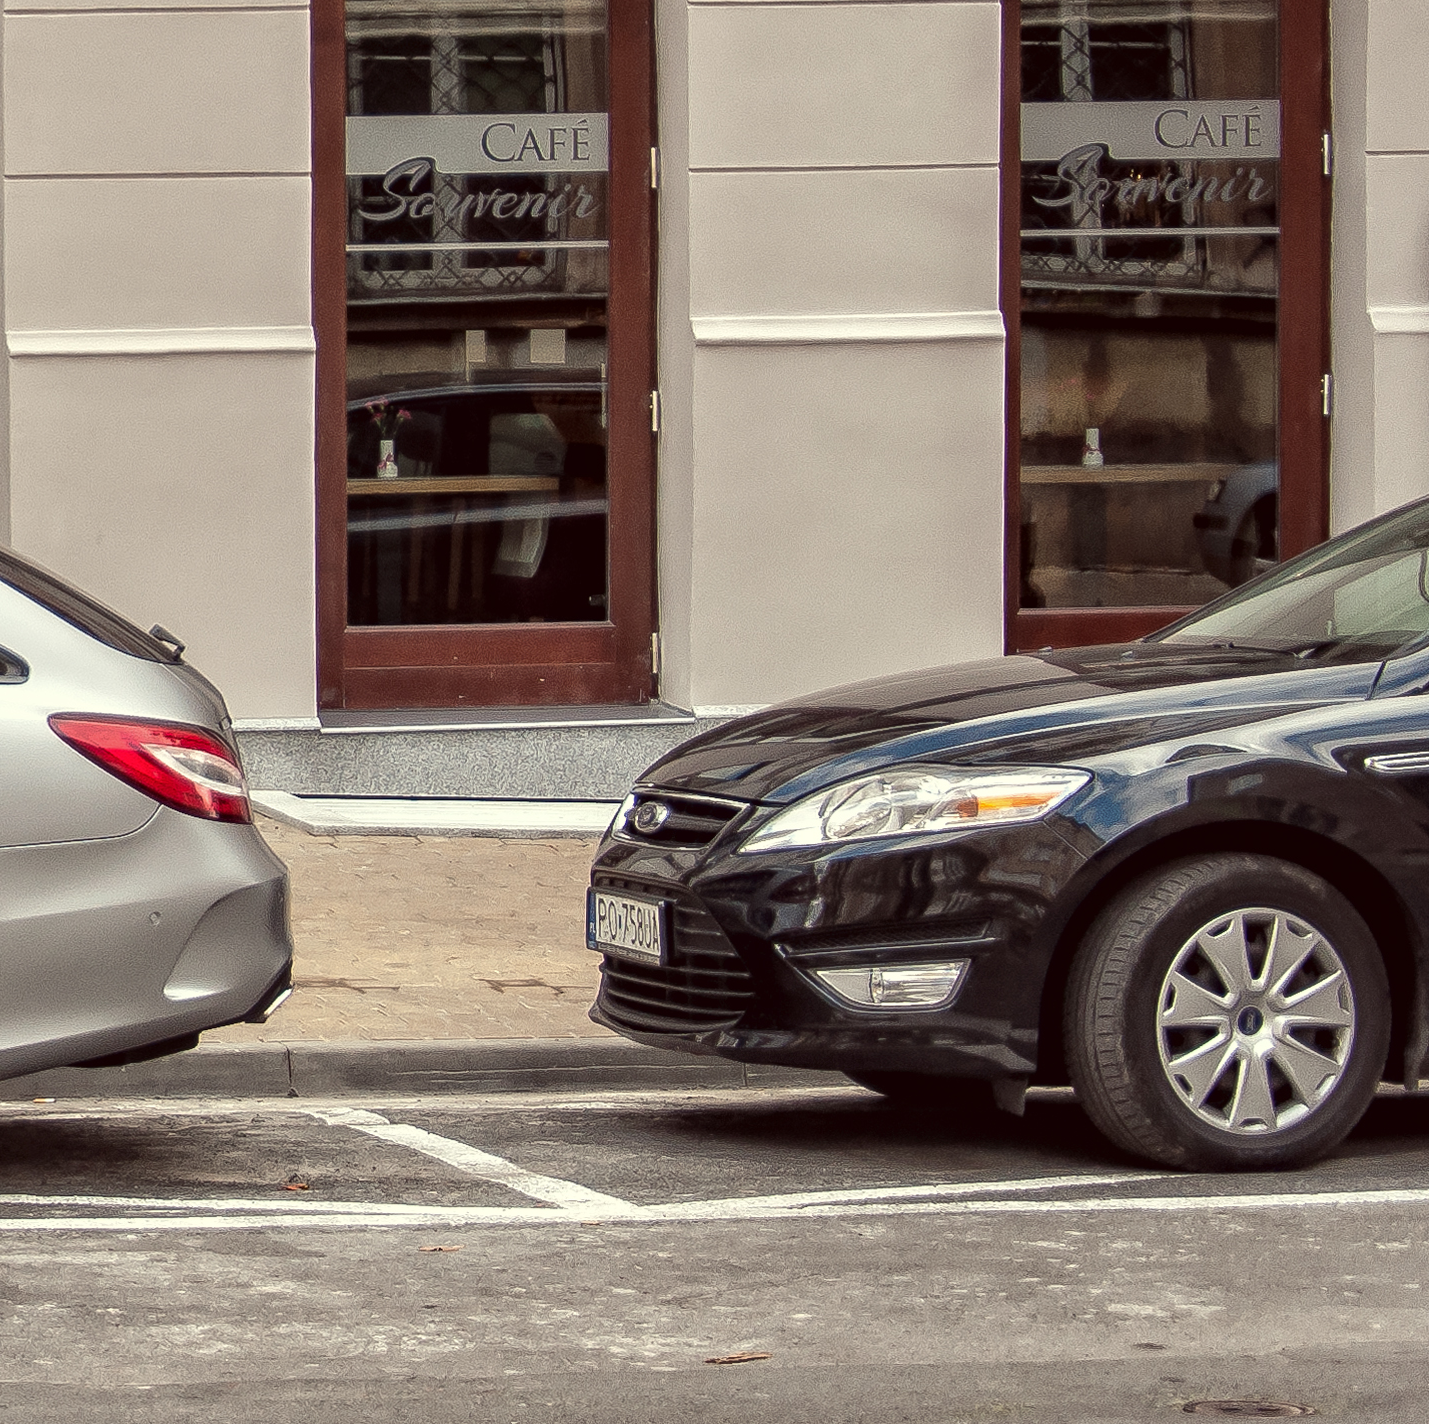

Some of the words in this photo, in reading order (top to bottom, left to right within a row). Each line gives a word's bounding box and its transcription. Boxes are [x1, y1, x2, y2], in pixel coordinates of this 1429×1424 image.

[480, 119, 591, 162] CAFÉ
[1154, 106, 1262, 149] CAFÉ
[358, 156, 602, 221] Souvenir
